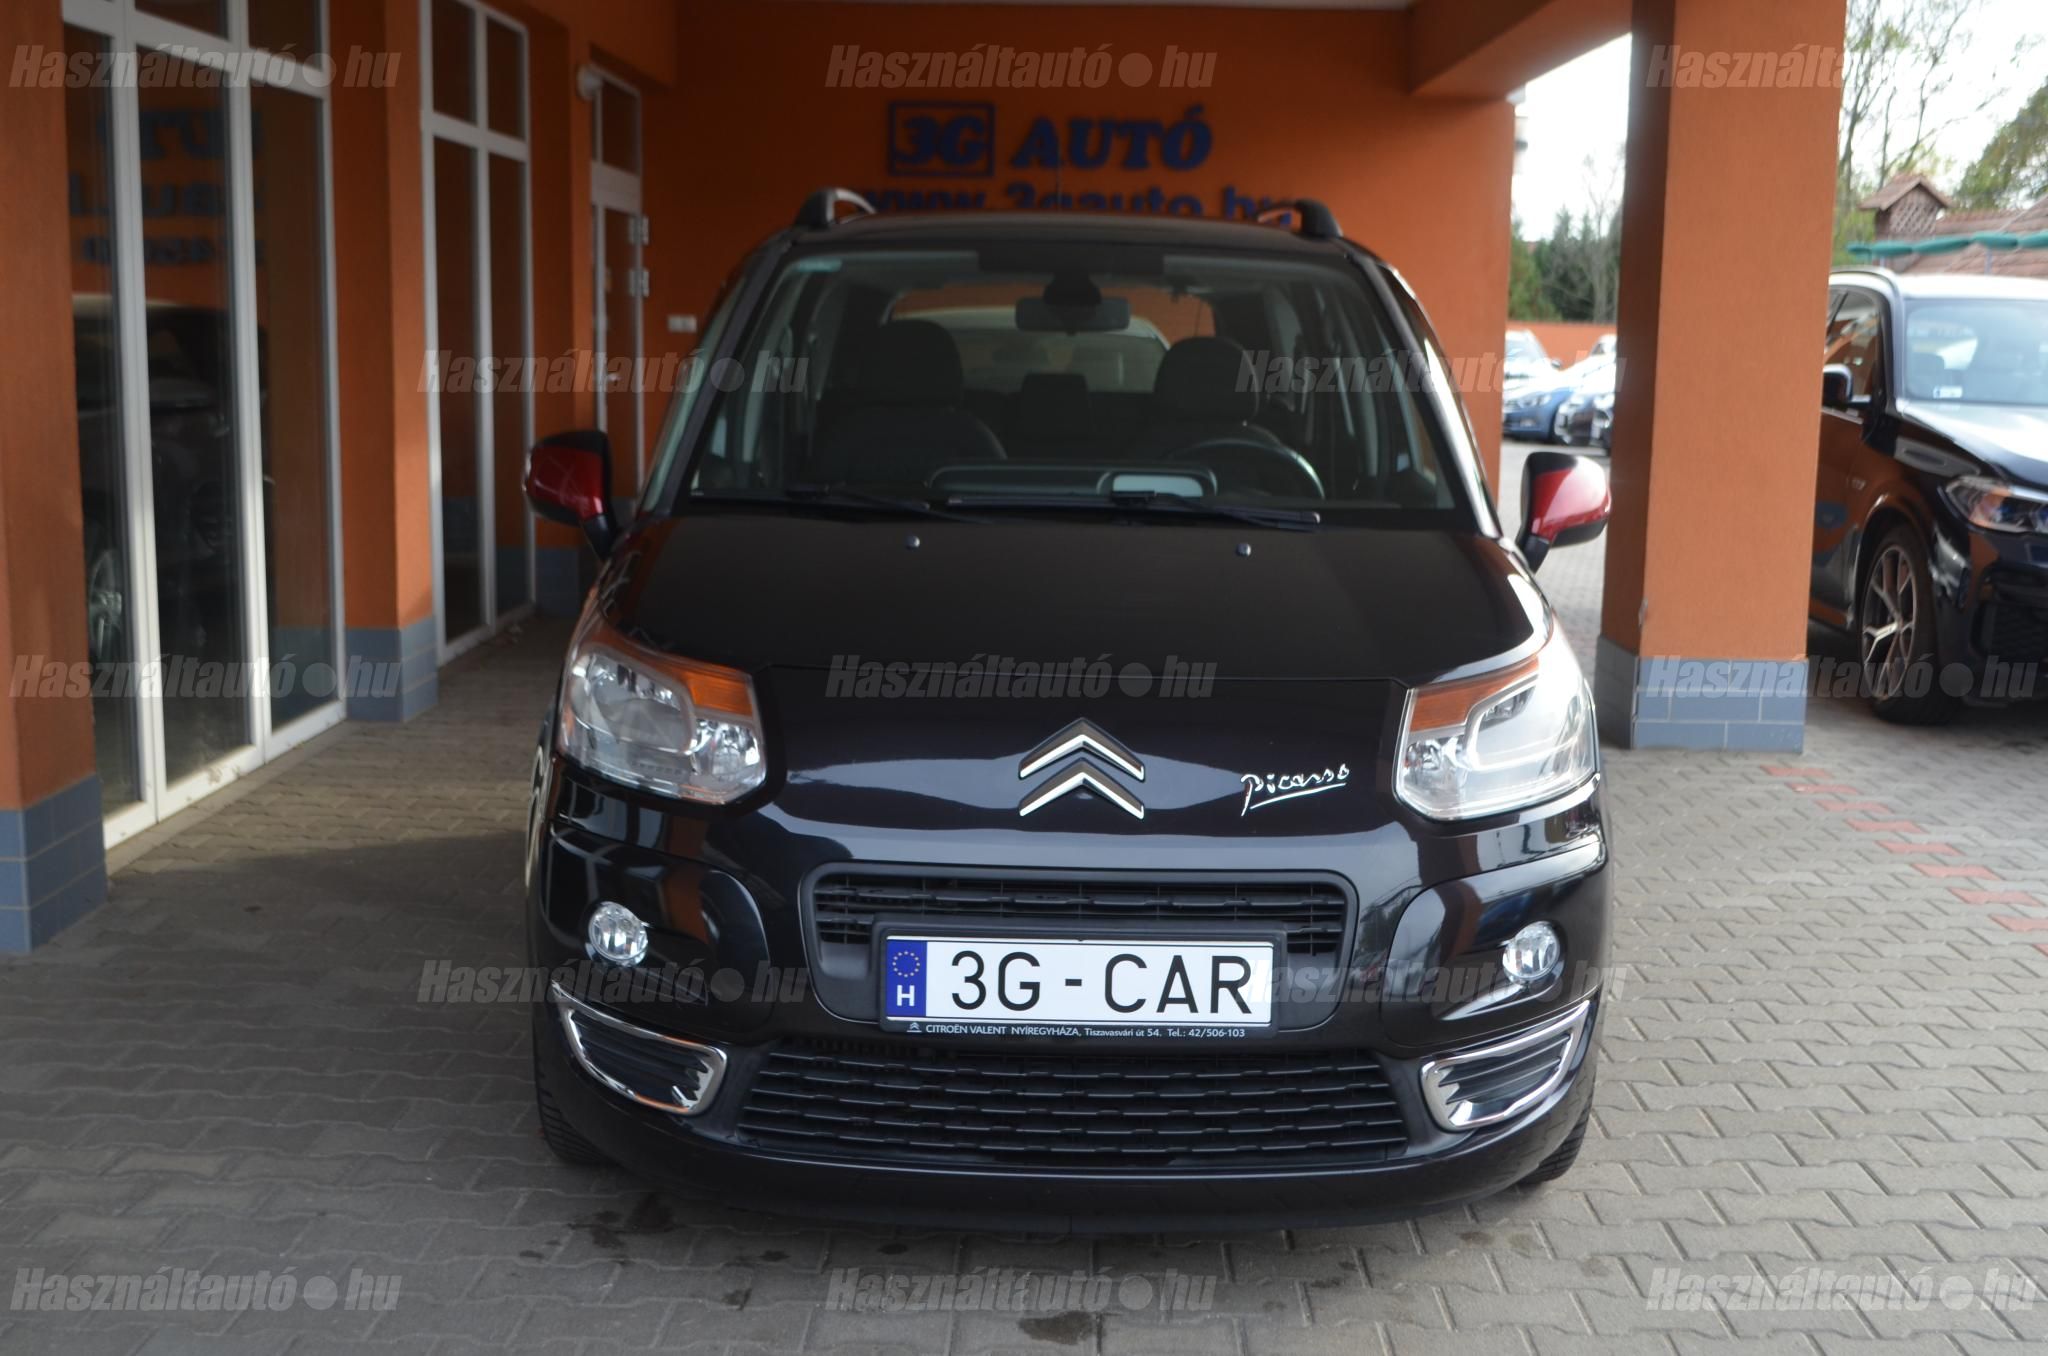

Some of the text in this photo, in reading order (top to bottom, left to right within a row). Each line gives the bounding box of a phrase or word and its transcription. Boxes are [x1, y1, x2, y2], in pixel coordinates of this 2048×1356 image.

[899, 104, 1213, 171] 3G AUTÓ
[896, 985, 915, 1006] H
[926, 1024, 968, 1034] CITROËN
[969, 1025, 1007, 1035] VALENT
[1084, 1027, 1133, 1037] Tiszavasvári
[1136, 1028, 1144, 1037] út
[1147, 1028, 1162, 1037] 54.
[1167, 1028, 1186, 1037] Tel.:
[1188, 1028, 1245, 1038] 42/506-103
